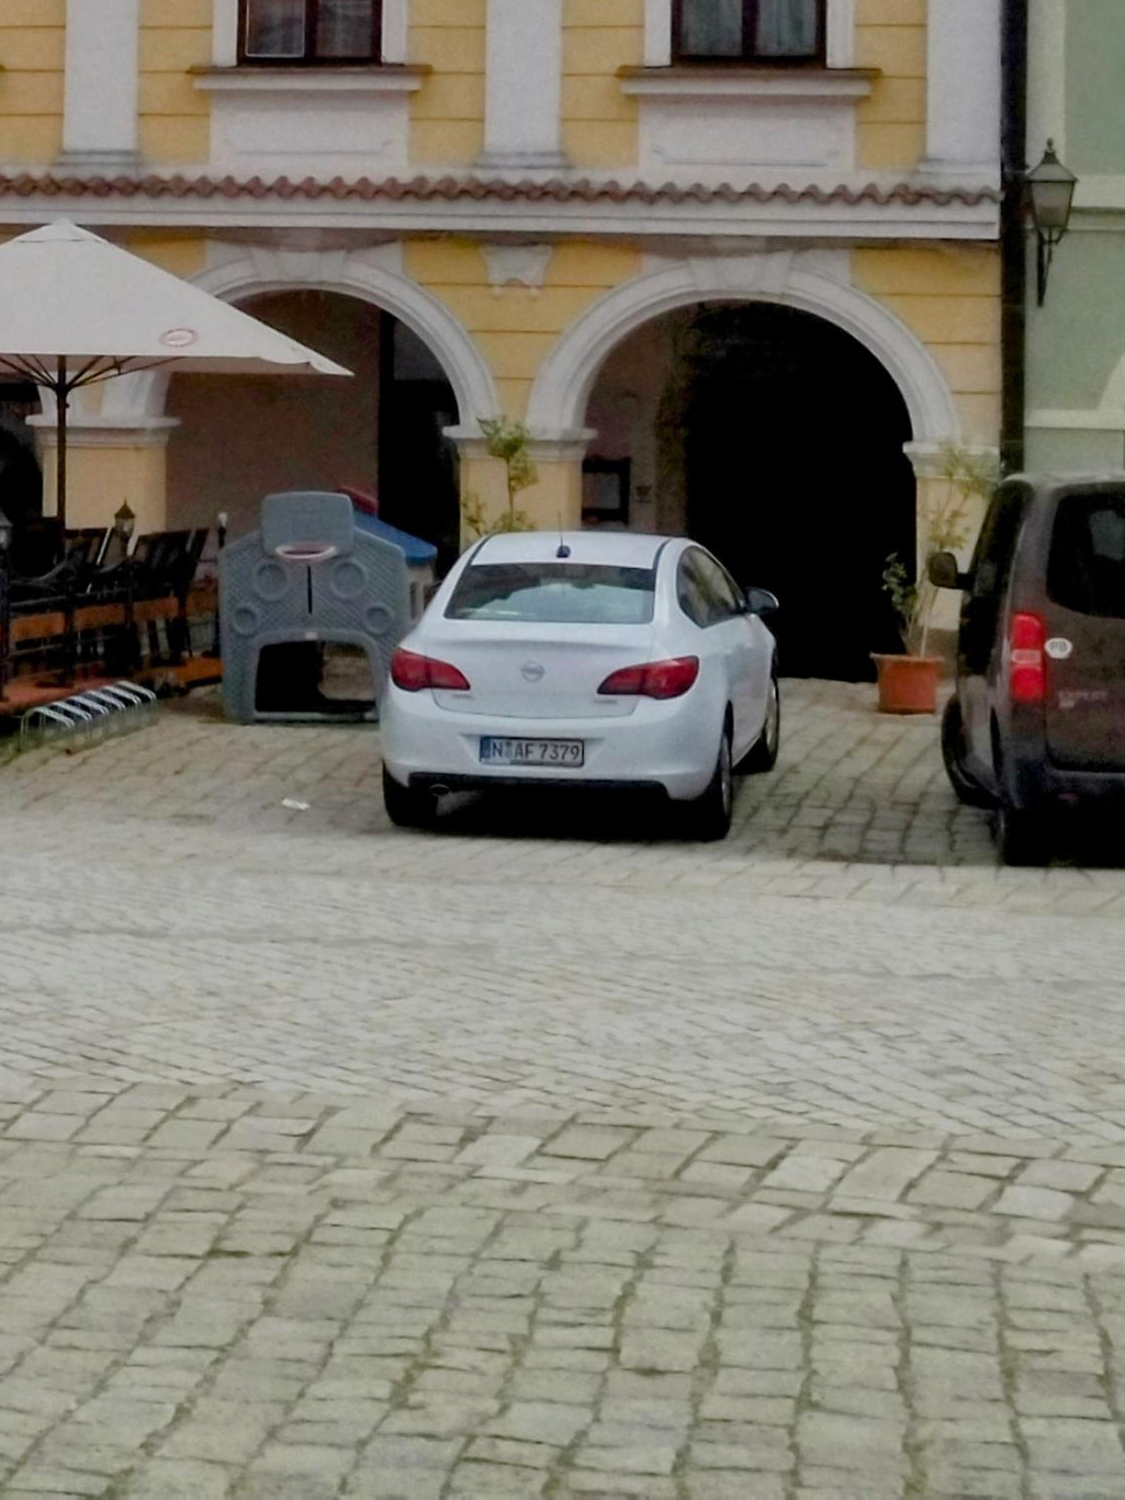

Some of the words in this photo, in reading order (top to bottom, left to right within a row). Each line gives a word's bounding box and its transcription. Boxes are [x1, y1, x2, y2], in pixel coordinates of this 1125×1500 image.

[492, 739, 504, 757] N
[515, 741, 536, 759] AF
[538, 743, 580, 761] 7379
